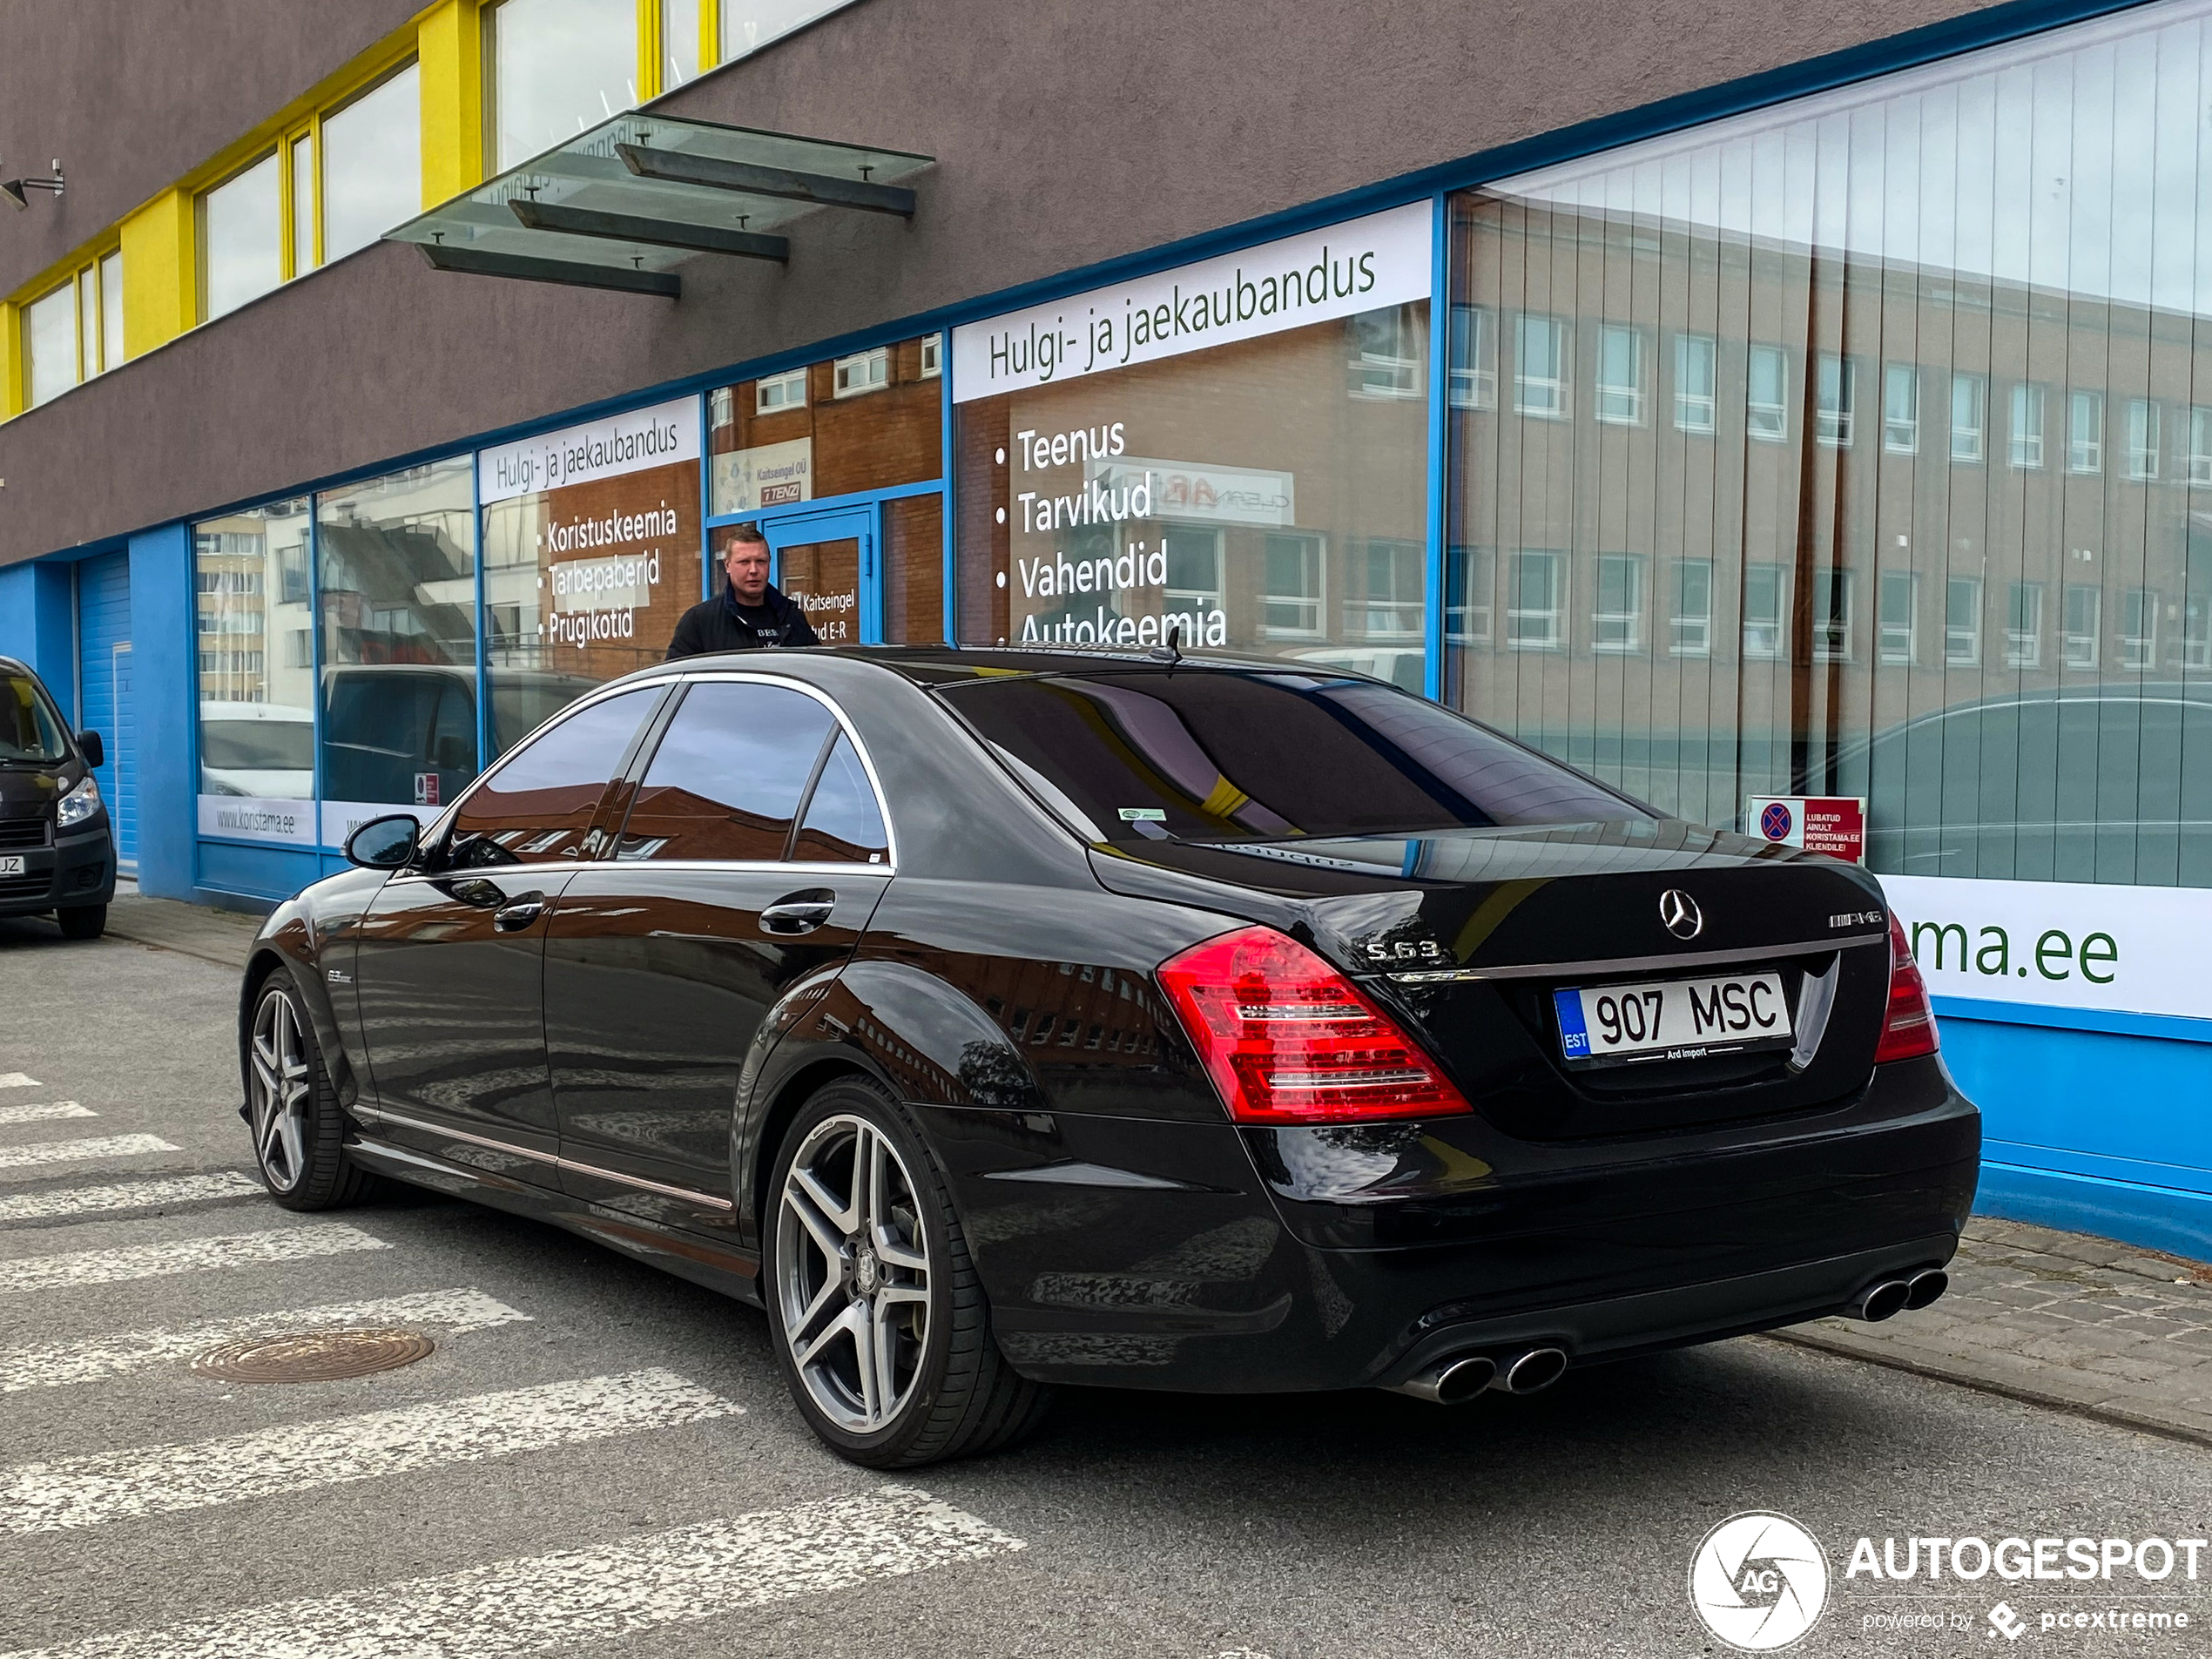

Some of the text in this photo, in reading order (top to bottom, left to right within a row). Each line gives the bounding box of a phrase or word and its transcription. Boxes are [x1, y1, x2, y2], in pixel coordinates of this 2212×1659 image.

[989, 246, 1376, 381] Hulgi- ja jaekaubandus
[497, 417, 677, 493] Hulgi- ja jaekaubandus
[1017, 421, 1125, 471] Teenus
[1017, 471, 1151, 533] Tarvikud
[548, 500, 677, 553] Koristuskeemia
[548, 548, 659, 600] Tarbepaberid
[1018, 538, 1168, 598] Vahendid
[803, 589, 854, 613] Kaitseingel
[550, 603, 633, 649] Prügikotid
[830, 621, 846, 639] E-R
[1022, 597, 1227, 646] Autokeemia
[217, 803, 294, 834] www.koristama.ee
[1805, 823, 1832, 832] AINULT
[1806, 813, 1841, 822] LUBATUD
[1805, 833, 1860, 843] KORISTAMA.EE
[1805, 842, 1846, 852] KLIENDILE!
[1366, 941, 1440, 961] S 63
[1596, 981, 1777, 1044] 907 MSC
[1565, 1033, 1588, 1049] EST
[1668, 1049, 1682, 1059] Ard
